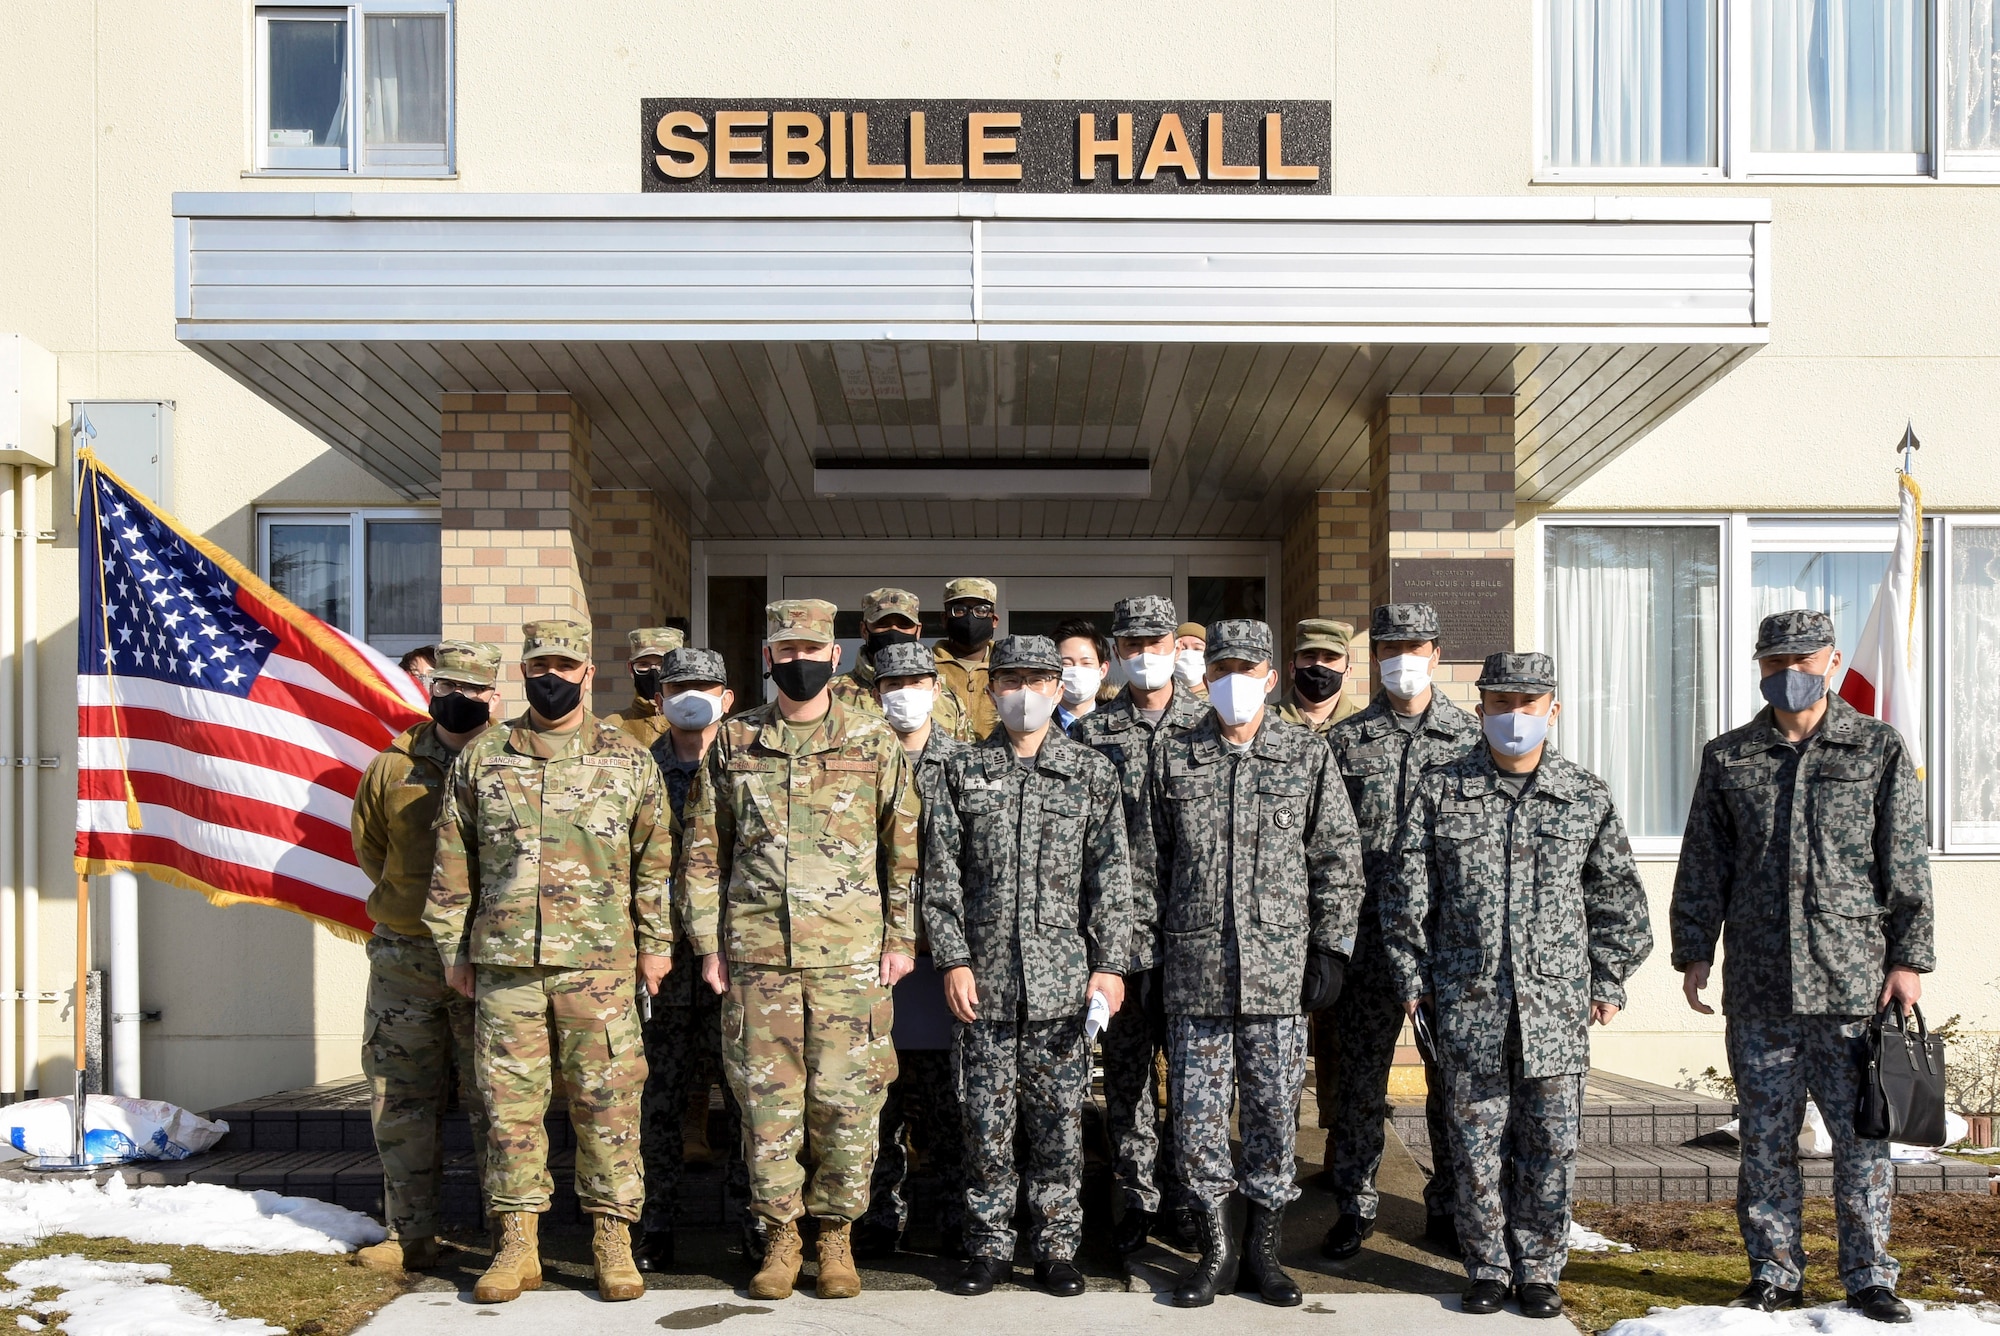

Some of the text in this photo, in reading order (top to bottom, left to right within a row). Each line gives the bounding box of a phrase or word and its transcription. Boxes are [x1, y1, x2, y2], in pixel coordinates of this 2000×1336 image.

[655, 111, 1319, 180] SEBILLE HALL
[489, 756, 522, 765] SANCHEZ
[610, 759, 630, 767] FORCE
